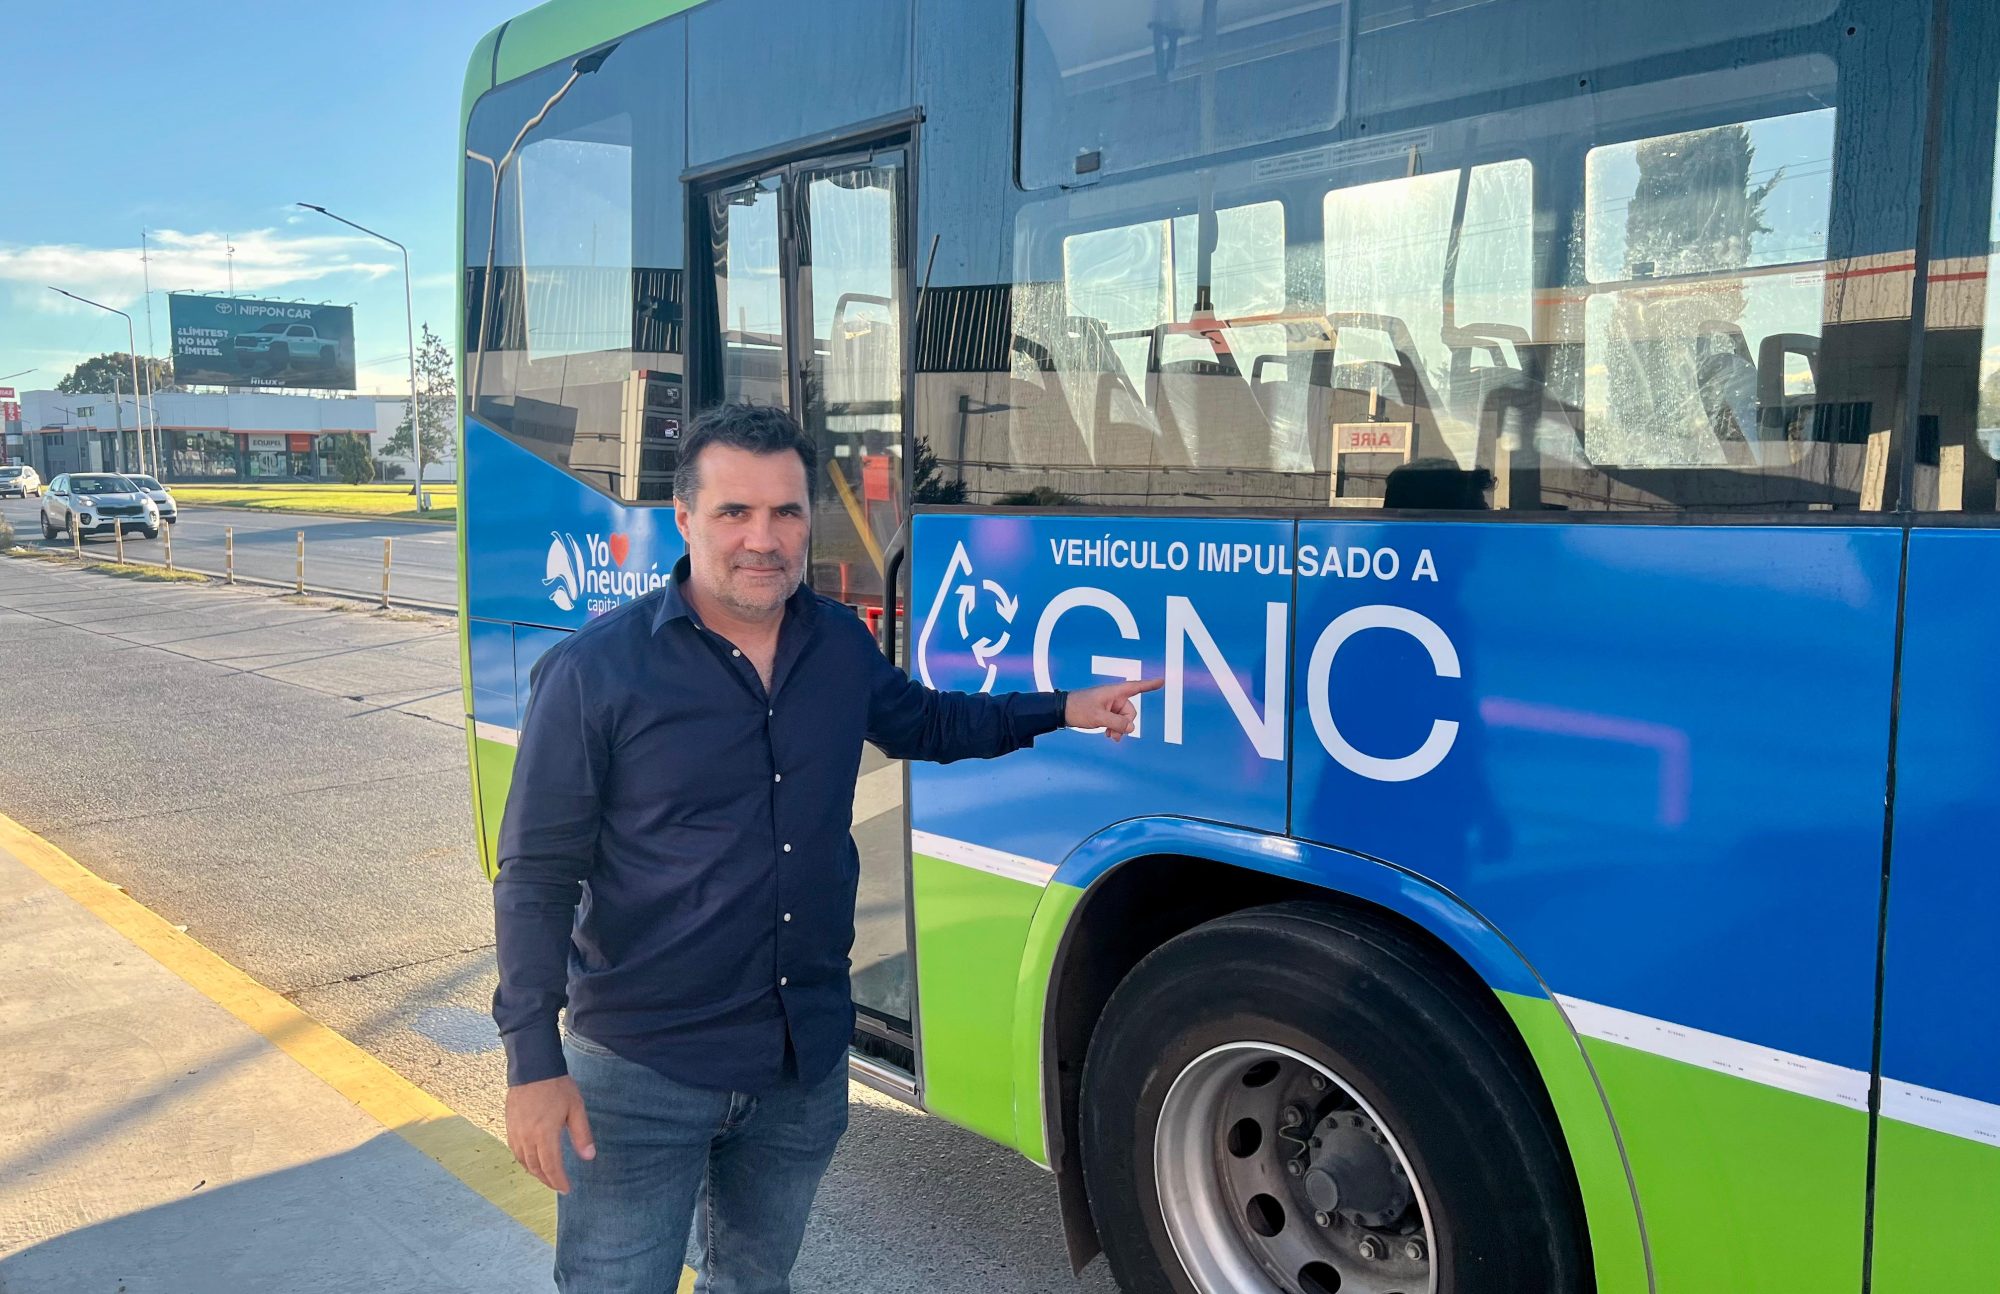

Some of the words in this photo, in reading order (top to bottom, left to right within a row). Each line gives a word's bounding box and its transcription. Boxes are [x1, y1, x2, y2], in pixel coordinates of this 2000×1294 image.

[240, 305, 285, 318] NIPPON
[287, 308, 312, 320] CAR
[177, 326, 229, 338] ¿LÍMITES?
[178, 337, 194, 346] NO
[196, 338, 218, 347] HAY
[250, 376, 278, 386] HILUX
[586, 533, 610, 567] Yo
[1050, 533, 1189, 571] VEHÍCULO
[1198, 542, 1400, 582] IMPULSADO
[1411, 548, 1440, 582] A
[1033, 586, 1462, 782] GNC
